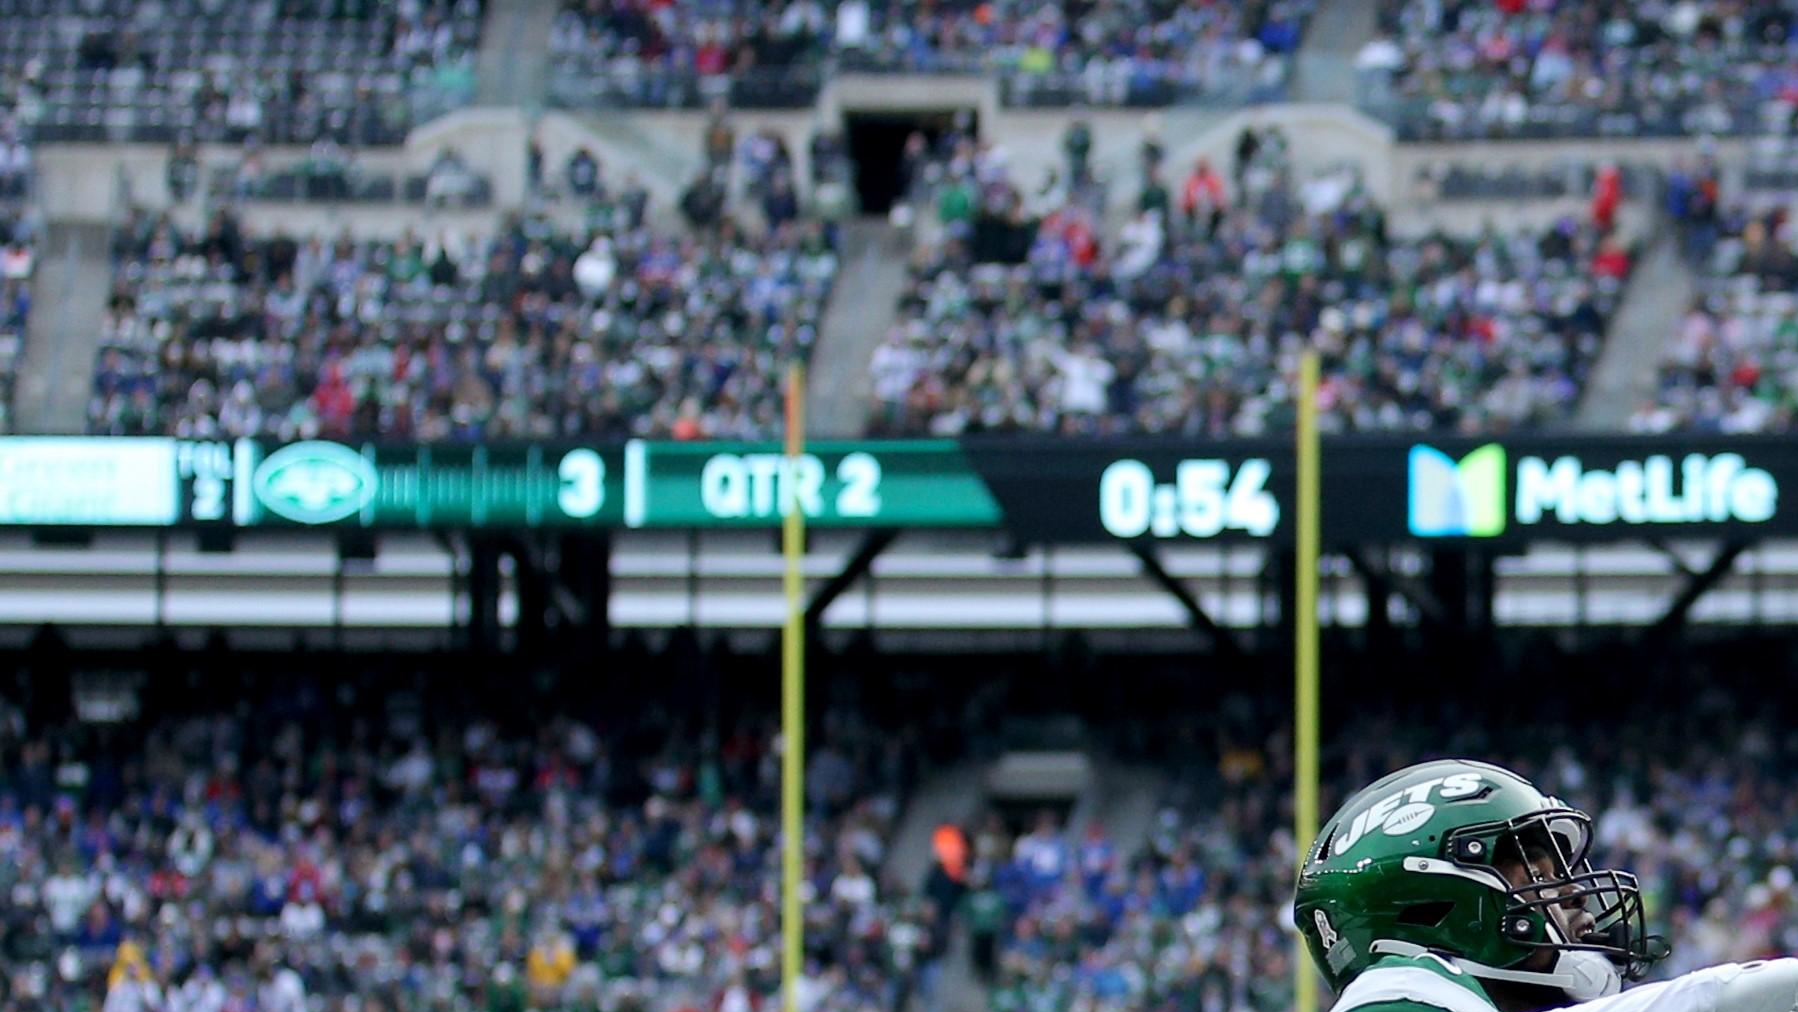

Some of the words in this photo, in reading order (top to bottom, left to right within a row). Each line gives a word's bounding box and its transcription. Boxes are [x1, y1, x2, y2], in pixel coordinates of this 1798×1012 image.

[557, 447, 605, 518] 3
[701, 453, 824, 518] QTR
[835, 451, 882, 517] 2
[1100, 457, 1280, 538] 0:54
[1515, 452, 1778, 524] MetLife
[1334, 772, 1485, 856] JETS
